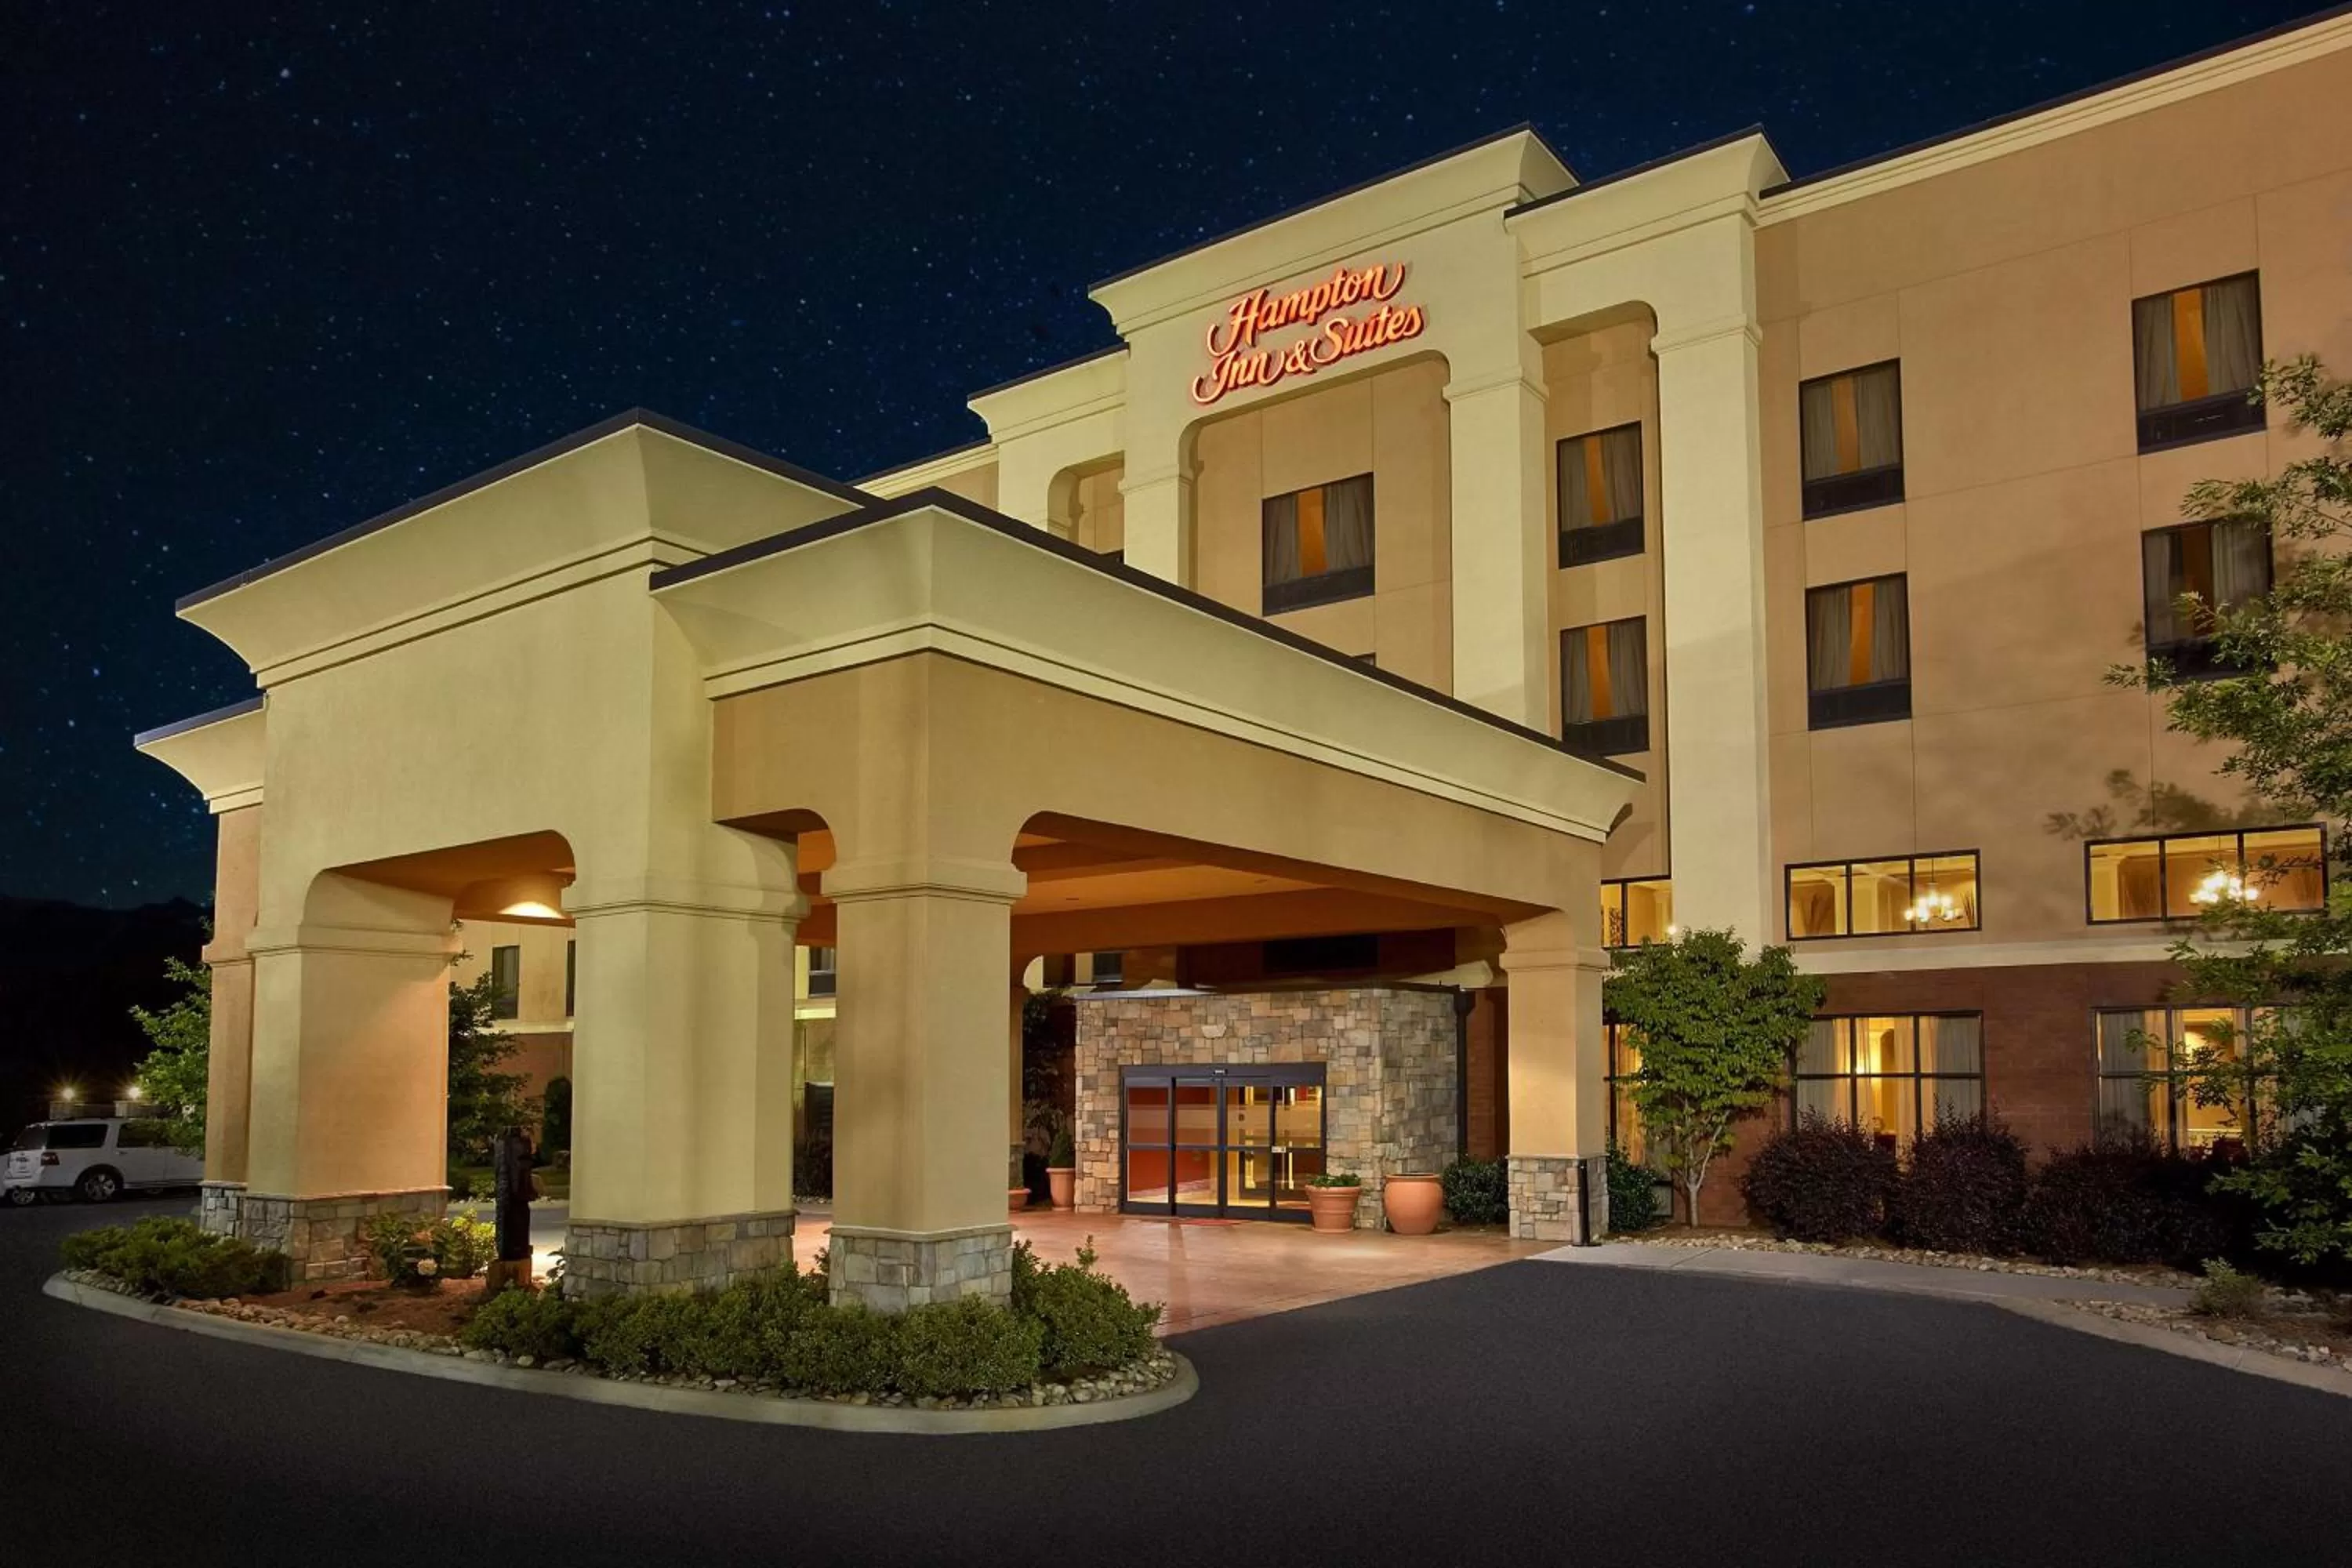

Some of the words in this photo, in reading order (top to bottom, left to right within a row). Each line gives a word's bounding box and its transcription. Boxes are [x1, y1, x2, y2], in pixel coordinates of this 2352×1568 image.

[1192, 350, 1286, 404] Inn
[1286, 339, 1316, 374] &
[1310, 305, 1425, 364] Suites
[1207, 263, 1406, 357] Hampton
